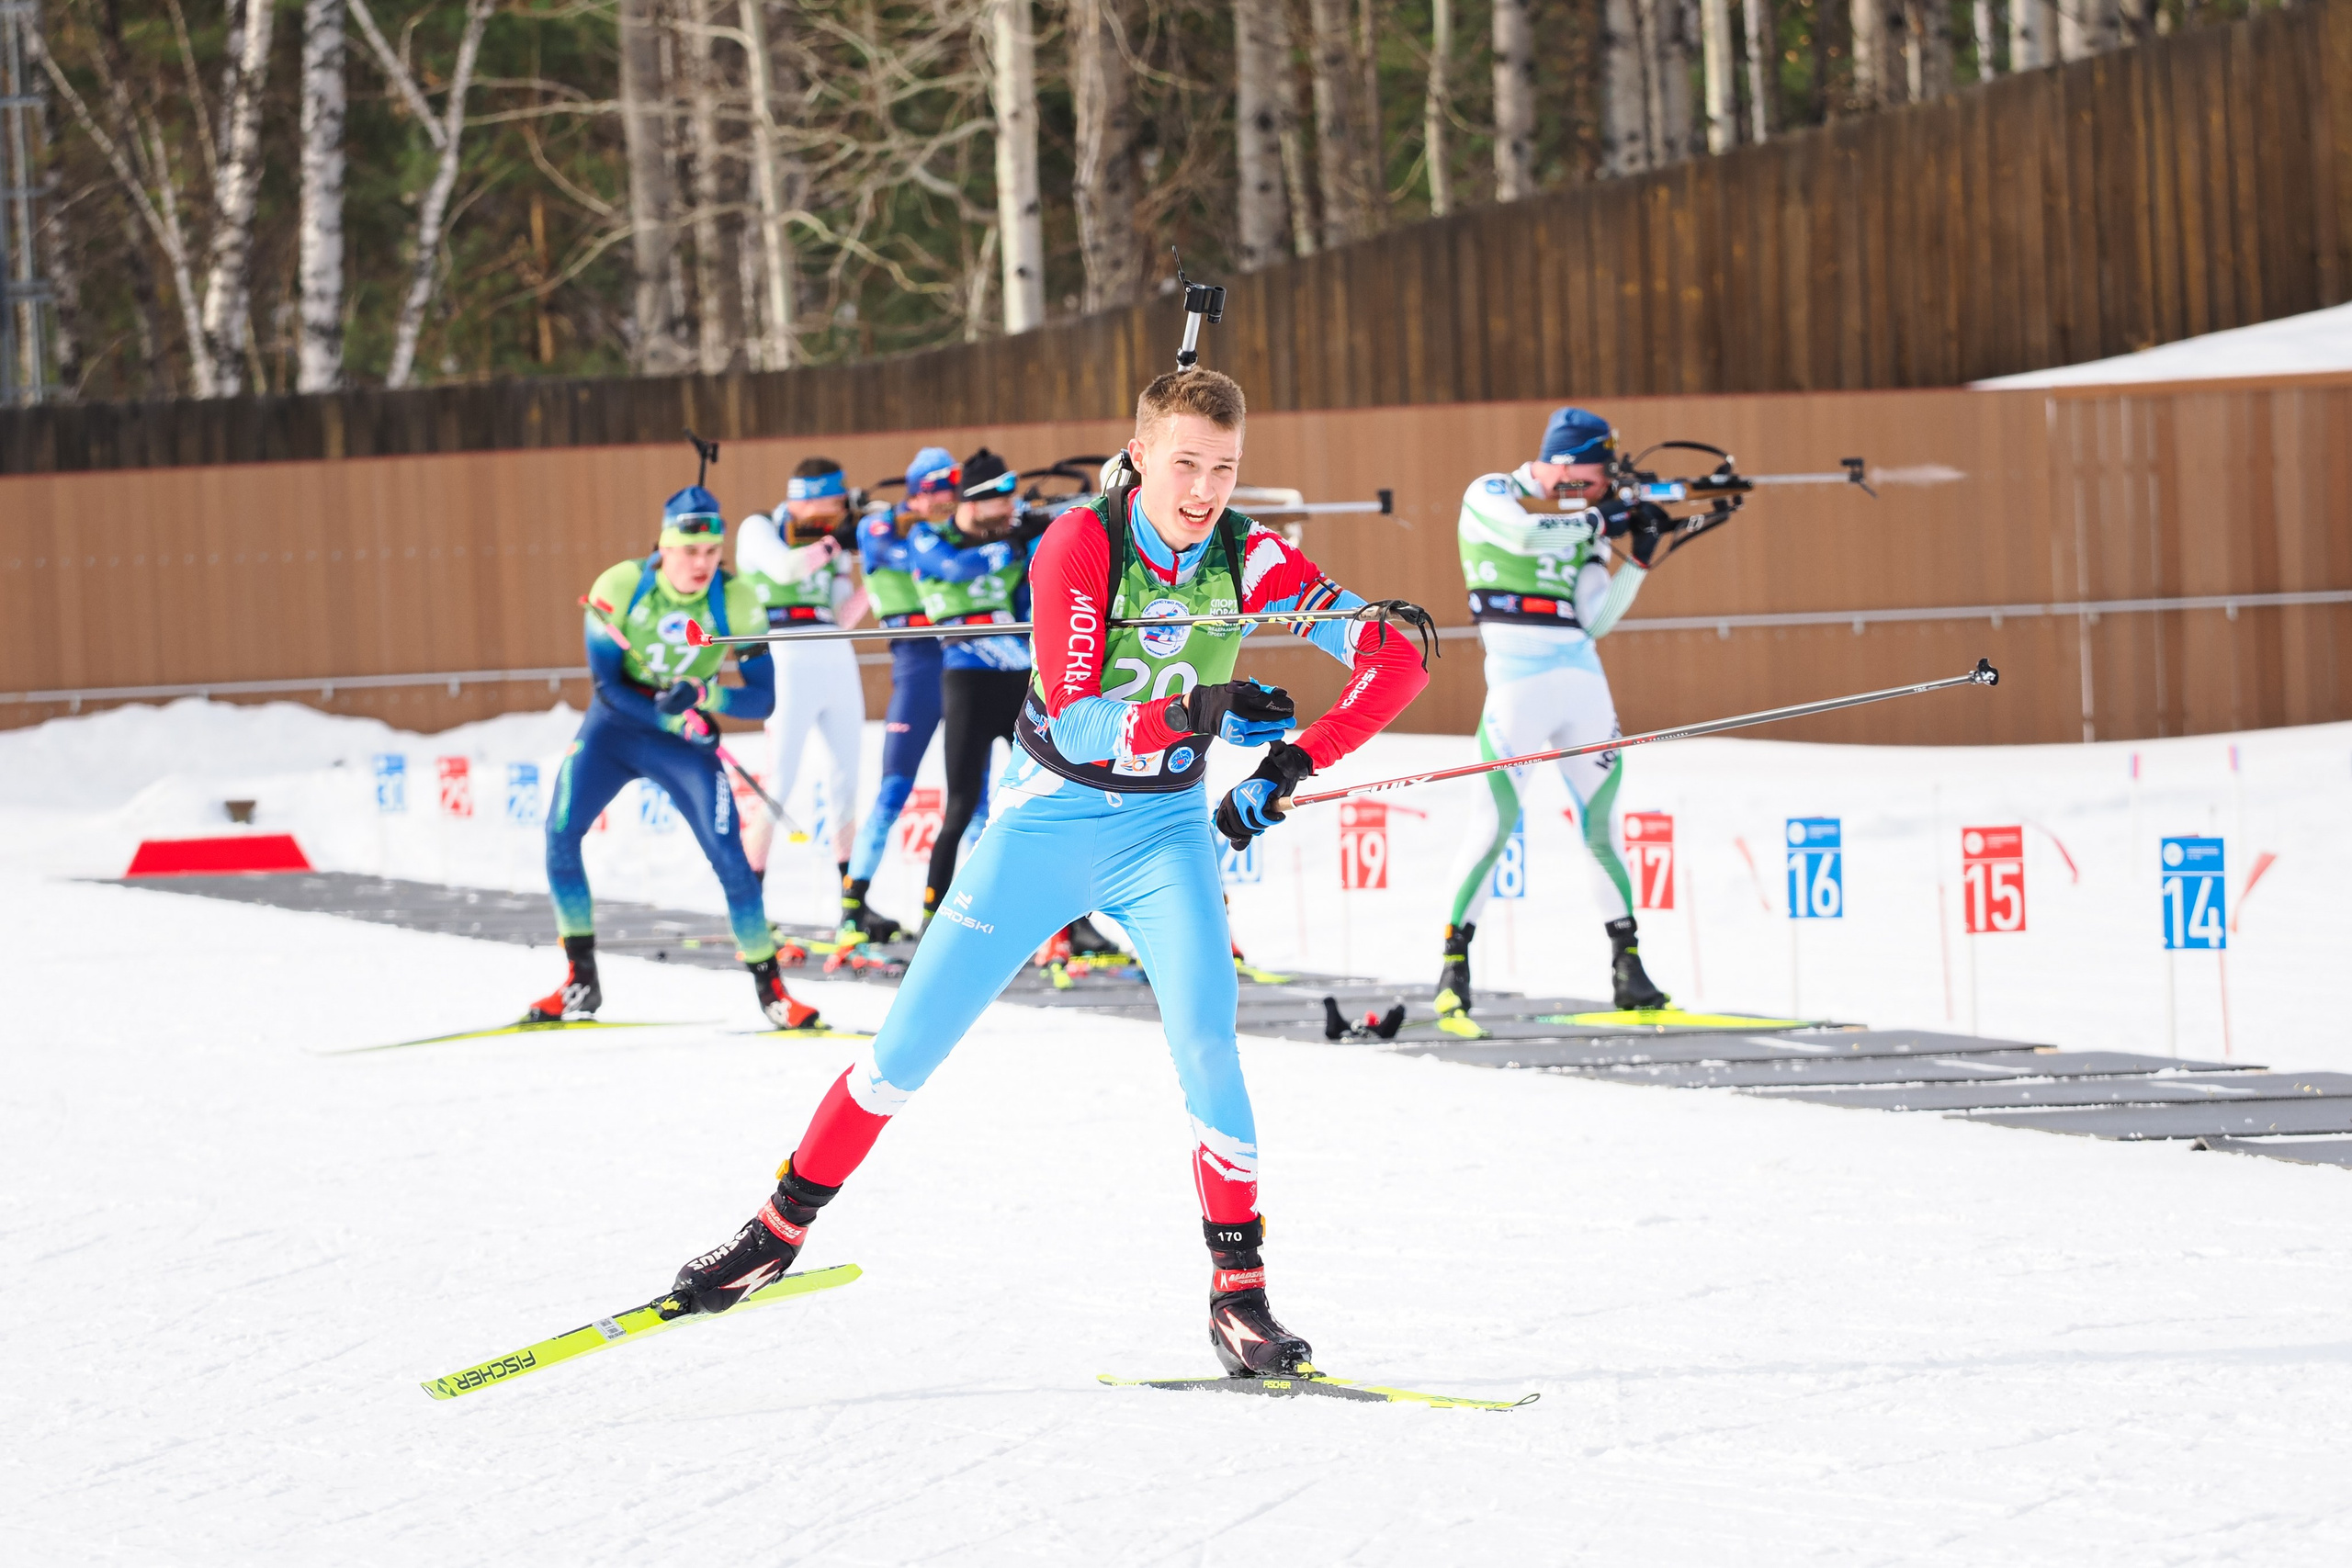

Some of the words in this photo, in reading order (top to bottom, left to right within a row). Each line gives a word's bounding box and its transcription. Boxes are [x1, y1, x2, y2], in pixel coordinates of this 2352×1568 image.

[1210, 599, 1238, 608] СПОРТ
[646, 643, 700, 674] 17
[1102, 657, 1198, 705] 20
[1342, 830, 1385, 888] 19
[1494, 838, 1524, 897] 8
[1627, 846, 1671, 908] 17
[1788, 852, 1840, 917] 16
[1964, 863, 2022, 931] 15
[937, 905, 995, 934] ORDSKI
[2163, 875, 2224, 948] 14
[1217, 1231, 1243, 1242] 170
[453, 1350, 536, 1390] FISCHER
[1263, 1381, 1291, 1390] FISCHER
